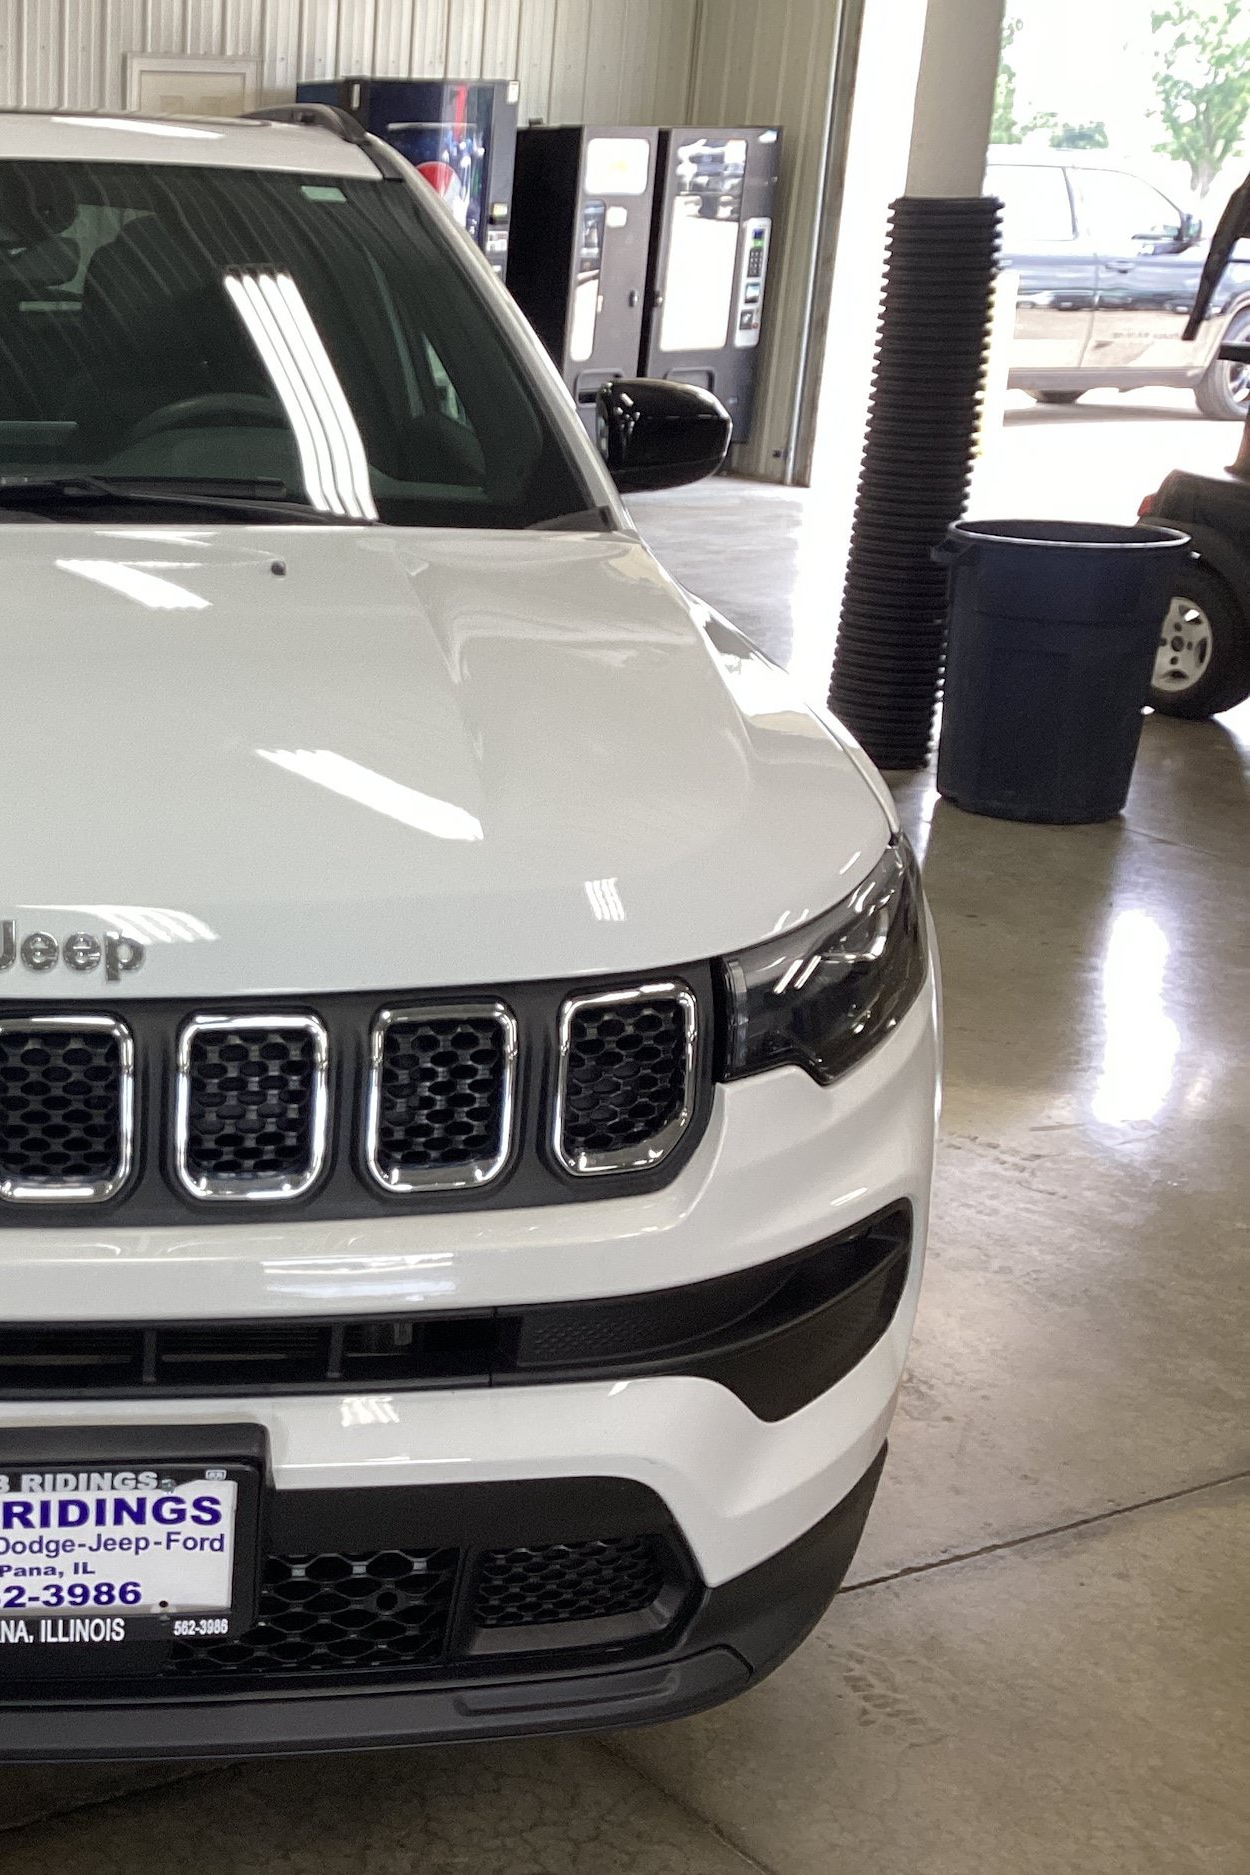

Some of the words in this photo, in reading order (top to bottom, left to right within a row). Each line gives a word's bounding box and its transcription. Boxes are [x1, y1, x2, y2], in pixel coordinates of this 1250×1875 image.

[21, 1471, 158, 1493] RIDINGS
[2, 1496, 223, 1530] RIDINGS
[73, 1562, 96, 1575] IL
[40, 1618, 126, 1643] ILLINOIS
[173, 1618, 229, 1636] 562-3986
